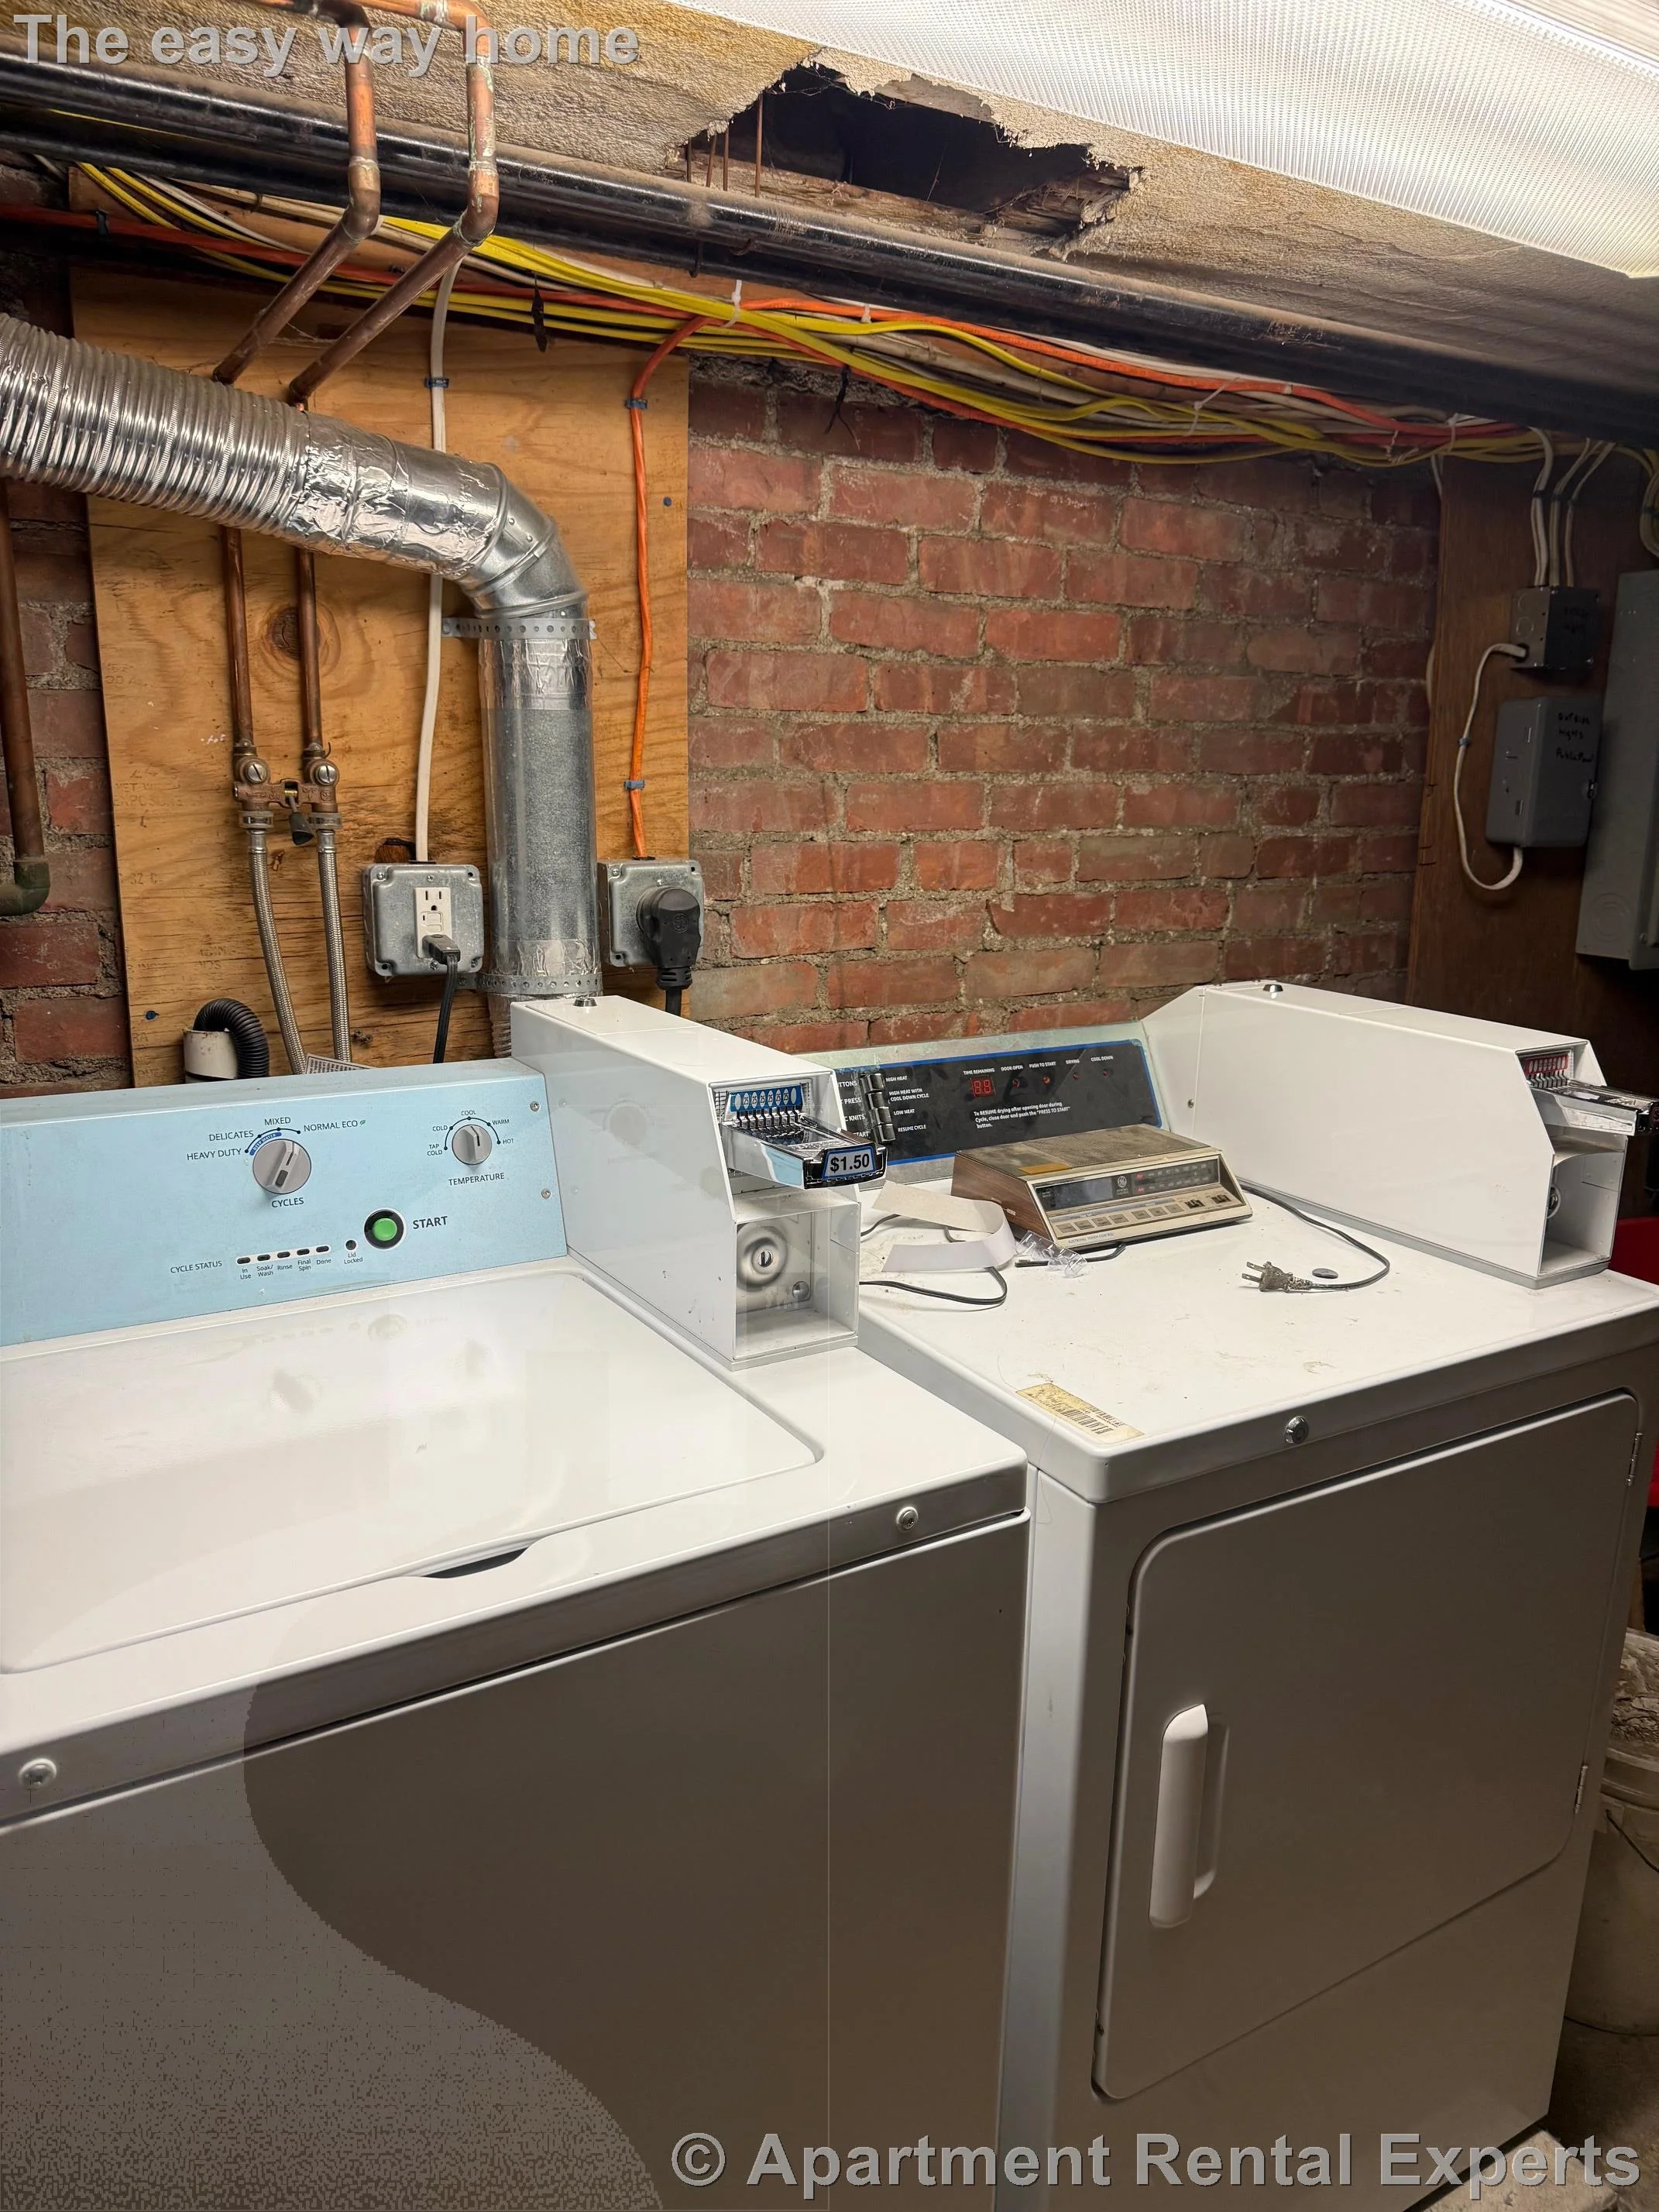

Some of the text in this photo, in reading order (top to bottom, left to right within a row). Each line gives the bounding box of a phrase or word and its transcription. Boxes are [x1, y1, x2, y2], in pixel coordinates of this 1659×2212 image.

[264, 1116, 291, 1126] MIXED
[304, 1120, 358, 1132] NORMAL ECO
[208, 1130, 254, 1142] DELICATES
[187, 1148, 242, 1161] HEAVY DUTY
[830, 1153, 870, 1173] $1.50
[448, 1172, 506, 1187] TEMPERATURE
[271, 1197, 304, 1208] CYCLES
[412, 1215, 448, 1229] START
[170, 1260, 223, 1274] CYCLE STATUS
[298, 1264, 311, 1273] Spin
